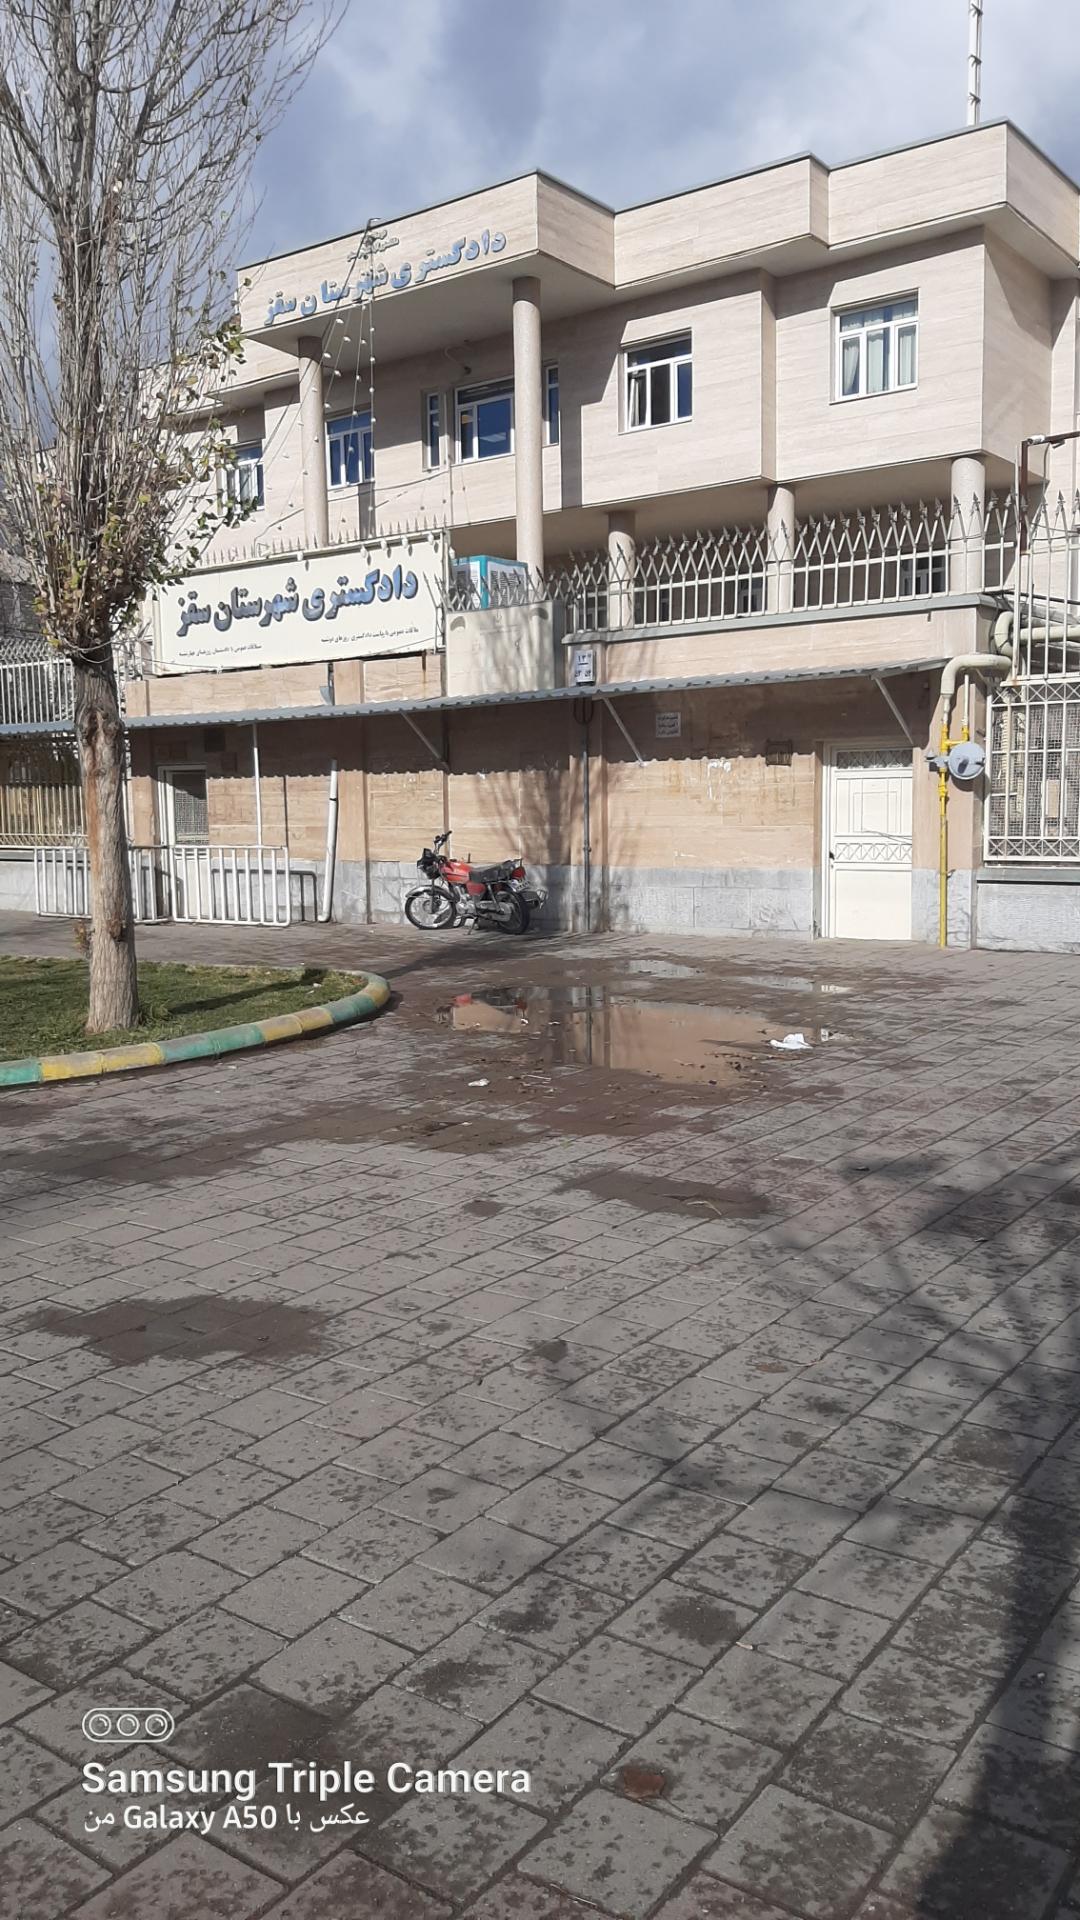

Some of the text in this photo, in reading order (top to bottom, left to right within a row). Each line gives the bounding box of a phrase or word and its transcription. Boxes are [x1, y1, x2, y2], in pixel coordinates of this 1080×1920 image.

[391, 229, 507, 289] دادگستری
[264, 290, 297, 326] سقز
[301, 263, 389, 315] شهرستان
[176, 564, 418, 637] دادگستری شهرستان سقز
